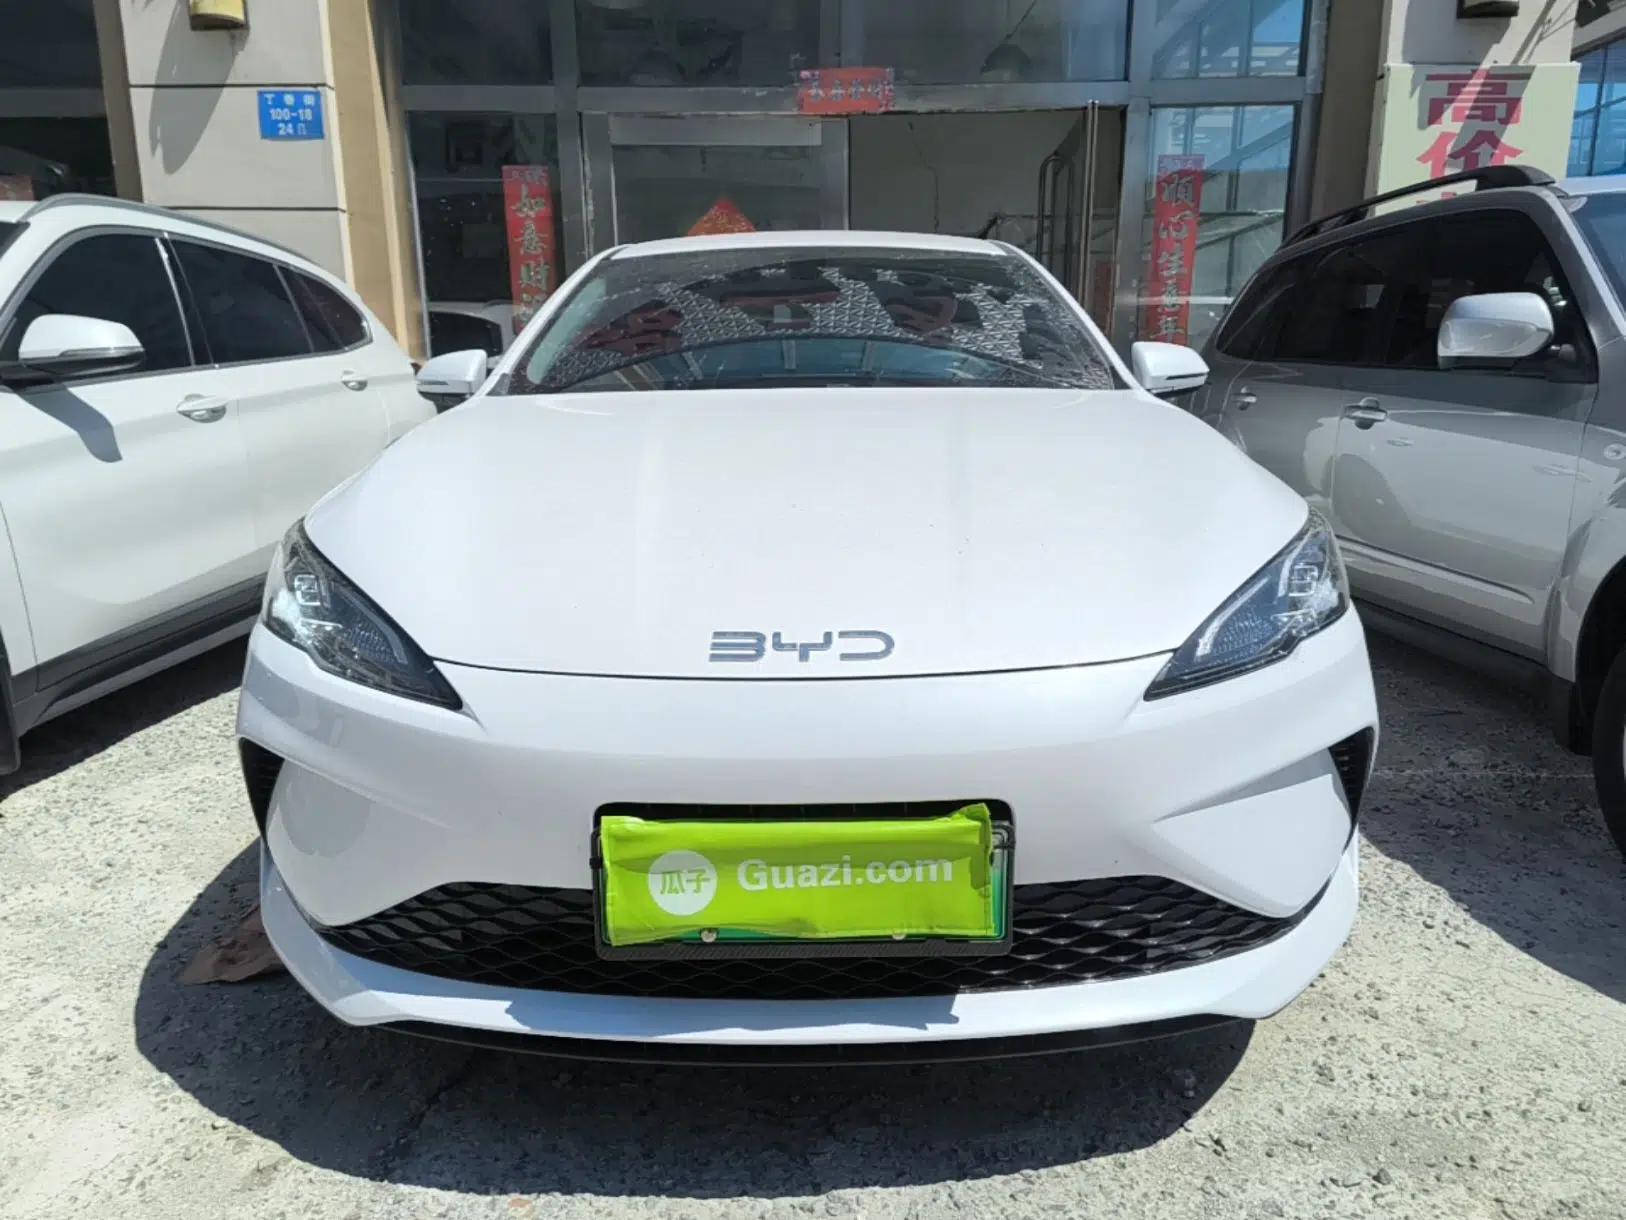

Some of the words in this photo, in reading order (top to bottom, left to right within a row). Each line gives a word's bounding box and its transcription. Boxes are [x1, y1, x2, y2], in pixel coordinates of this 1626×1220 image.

[1416, 69, 1532, 202] 高价
[708, 630, 895, 663] BYD
[660, 868, 711, 896] 瓜子
[736, 855, 954, 892] Guazi.com
